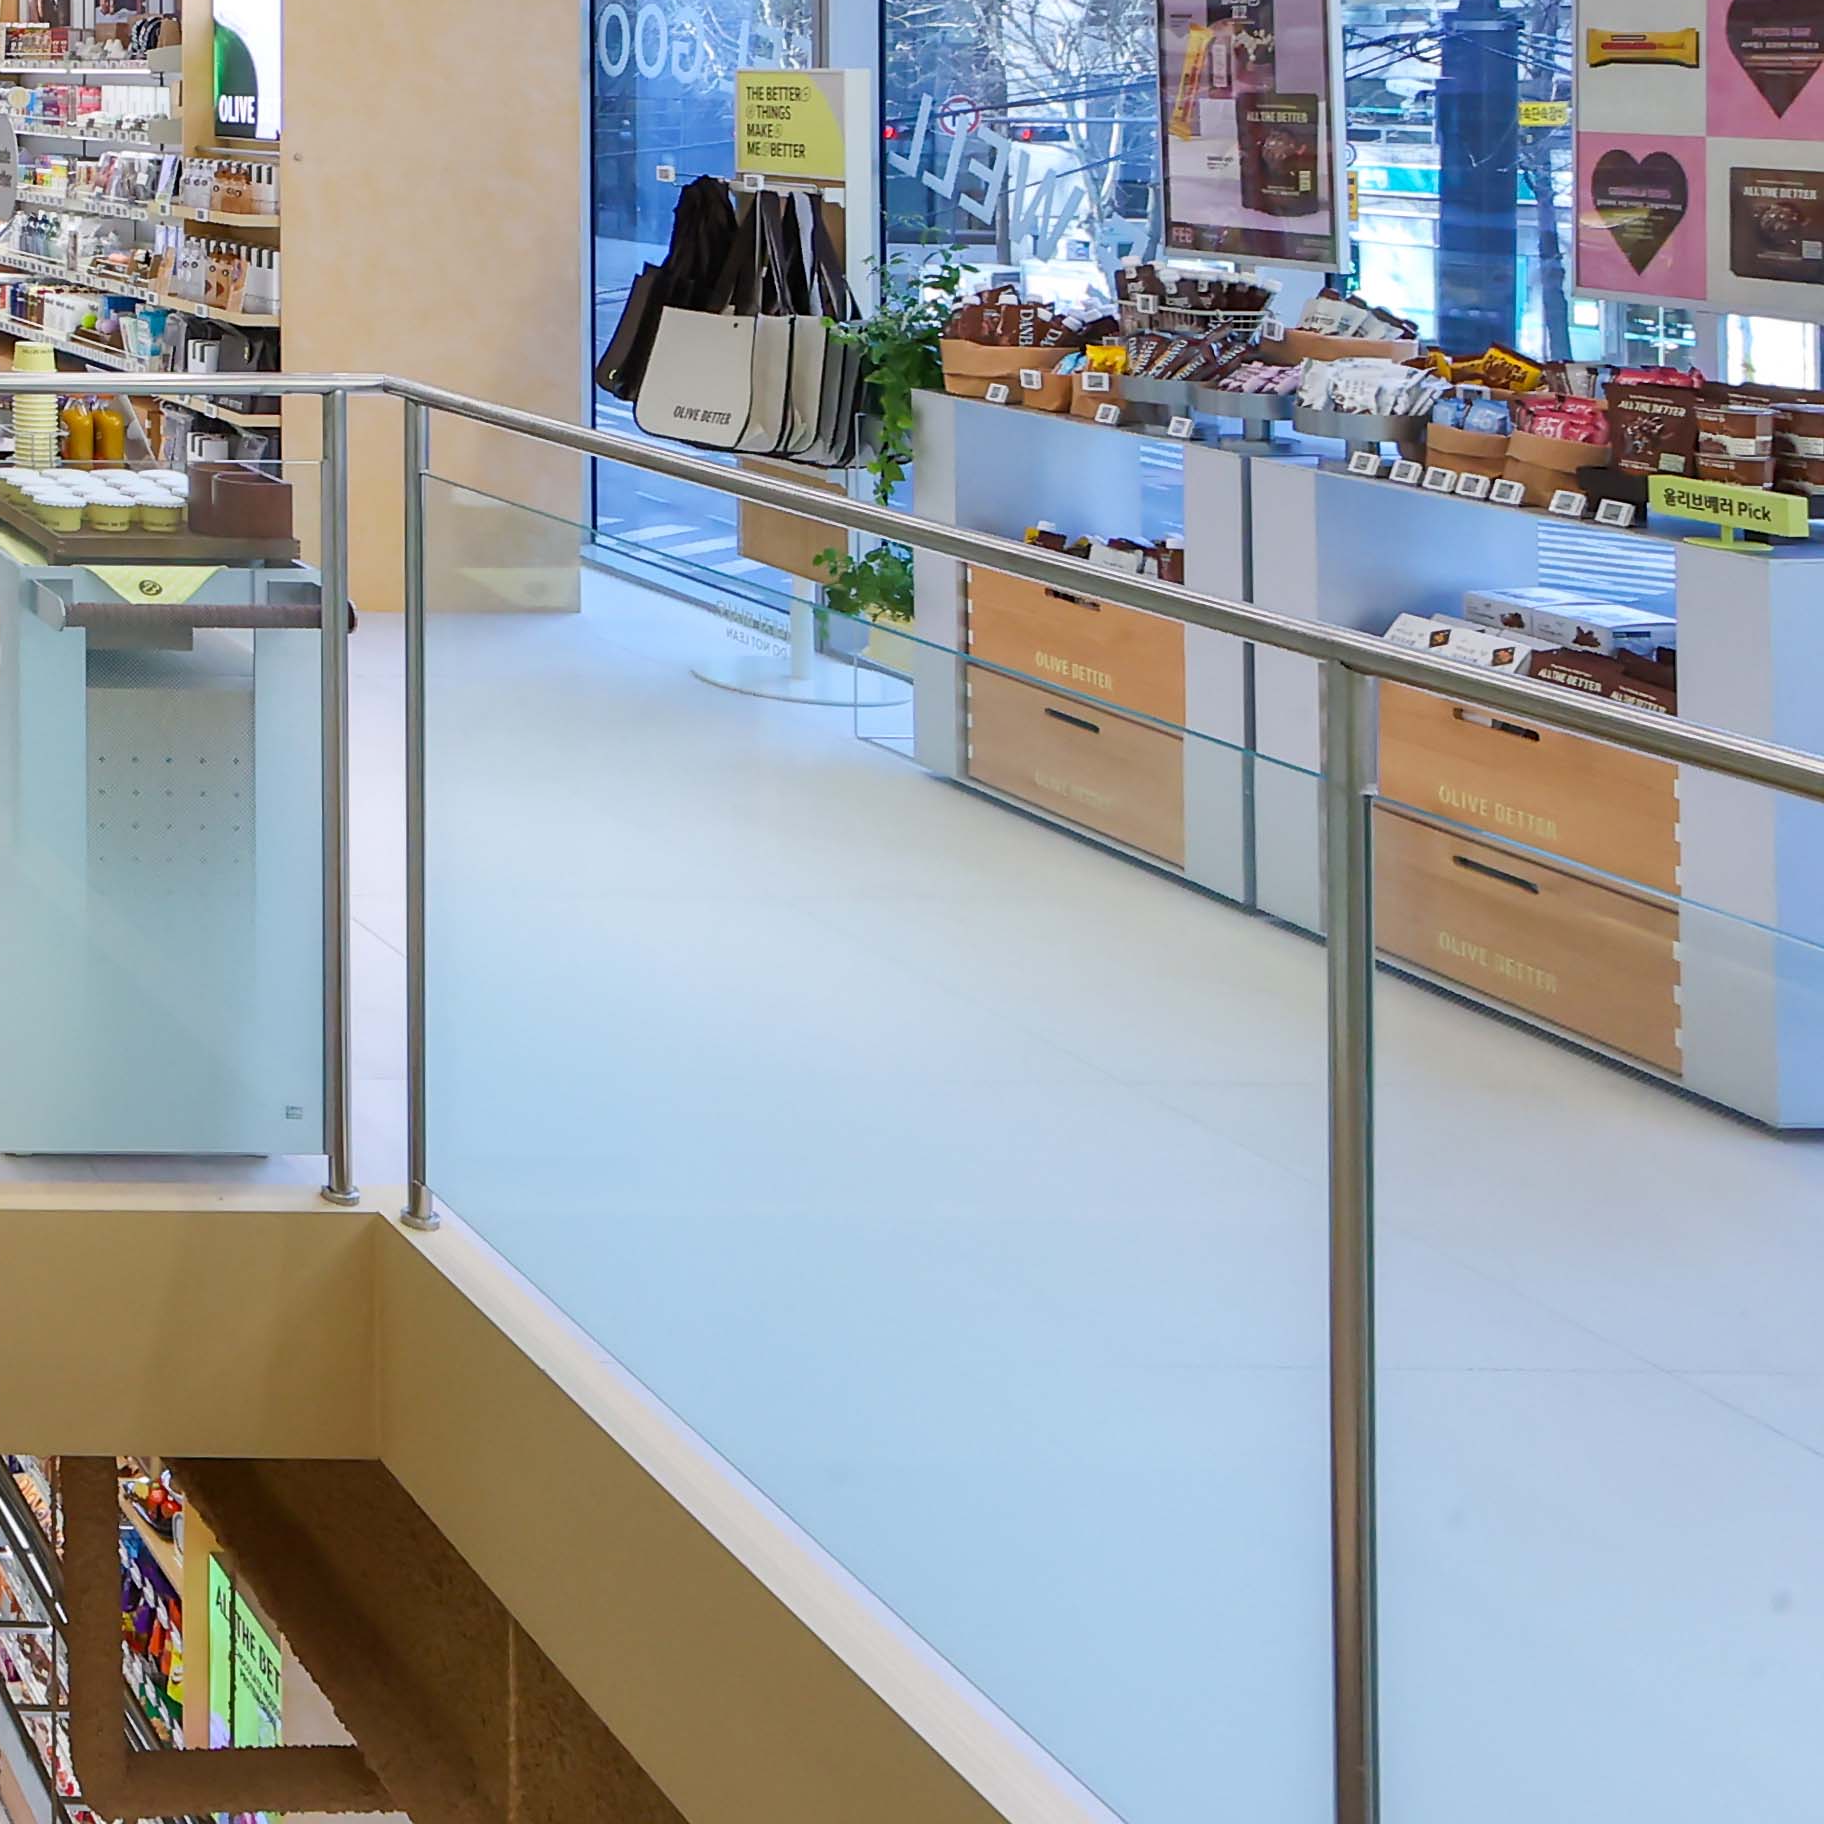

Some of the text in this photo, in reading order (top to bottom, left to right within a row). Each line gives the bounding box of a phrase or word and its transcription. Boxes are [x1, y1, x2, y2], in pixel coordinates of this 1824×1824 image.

[746, 86, 801, 101] THE BETTER
[218, 94, 256, 125] OLIVE
[757, 105, 791, 120] THINGS
[746, 124, 772, 138] MAKE
[747, 142, 806, 158] ME BETTER
[1779, 187, 1817, 200] BETTER
[673, 405, 732, 425] OLIVE BETTER
[1651, 404, 1687, 417] BETTER
[1662, 487, 1773, 524] 올리브베러 Pick
[1035, 650, 1113, 690] OLIVE BETTER
[1438, 784, 1558, 841] OLIVE BETTER
[1439, 931, 1558, 994] OLIVE BETTER
